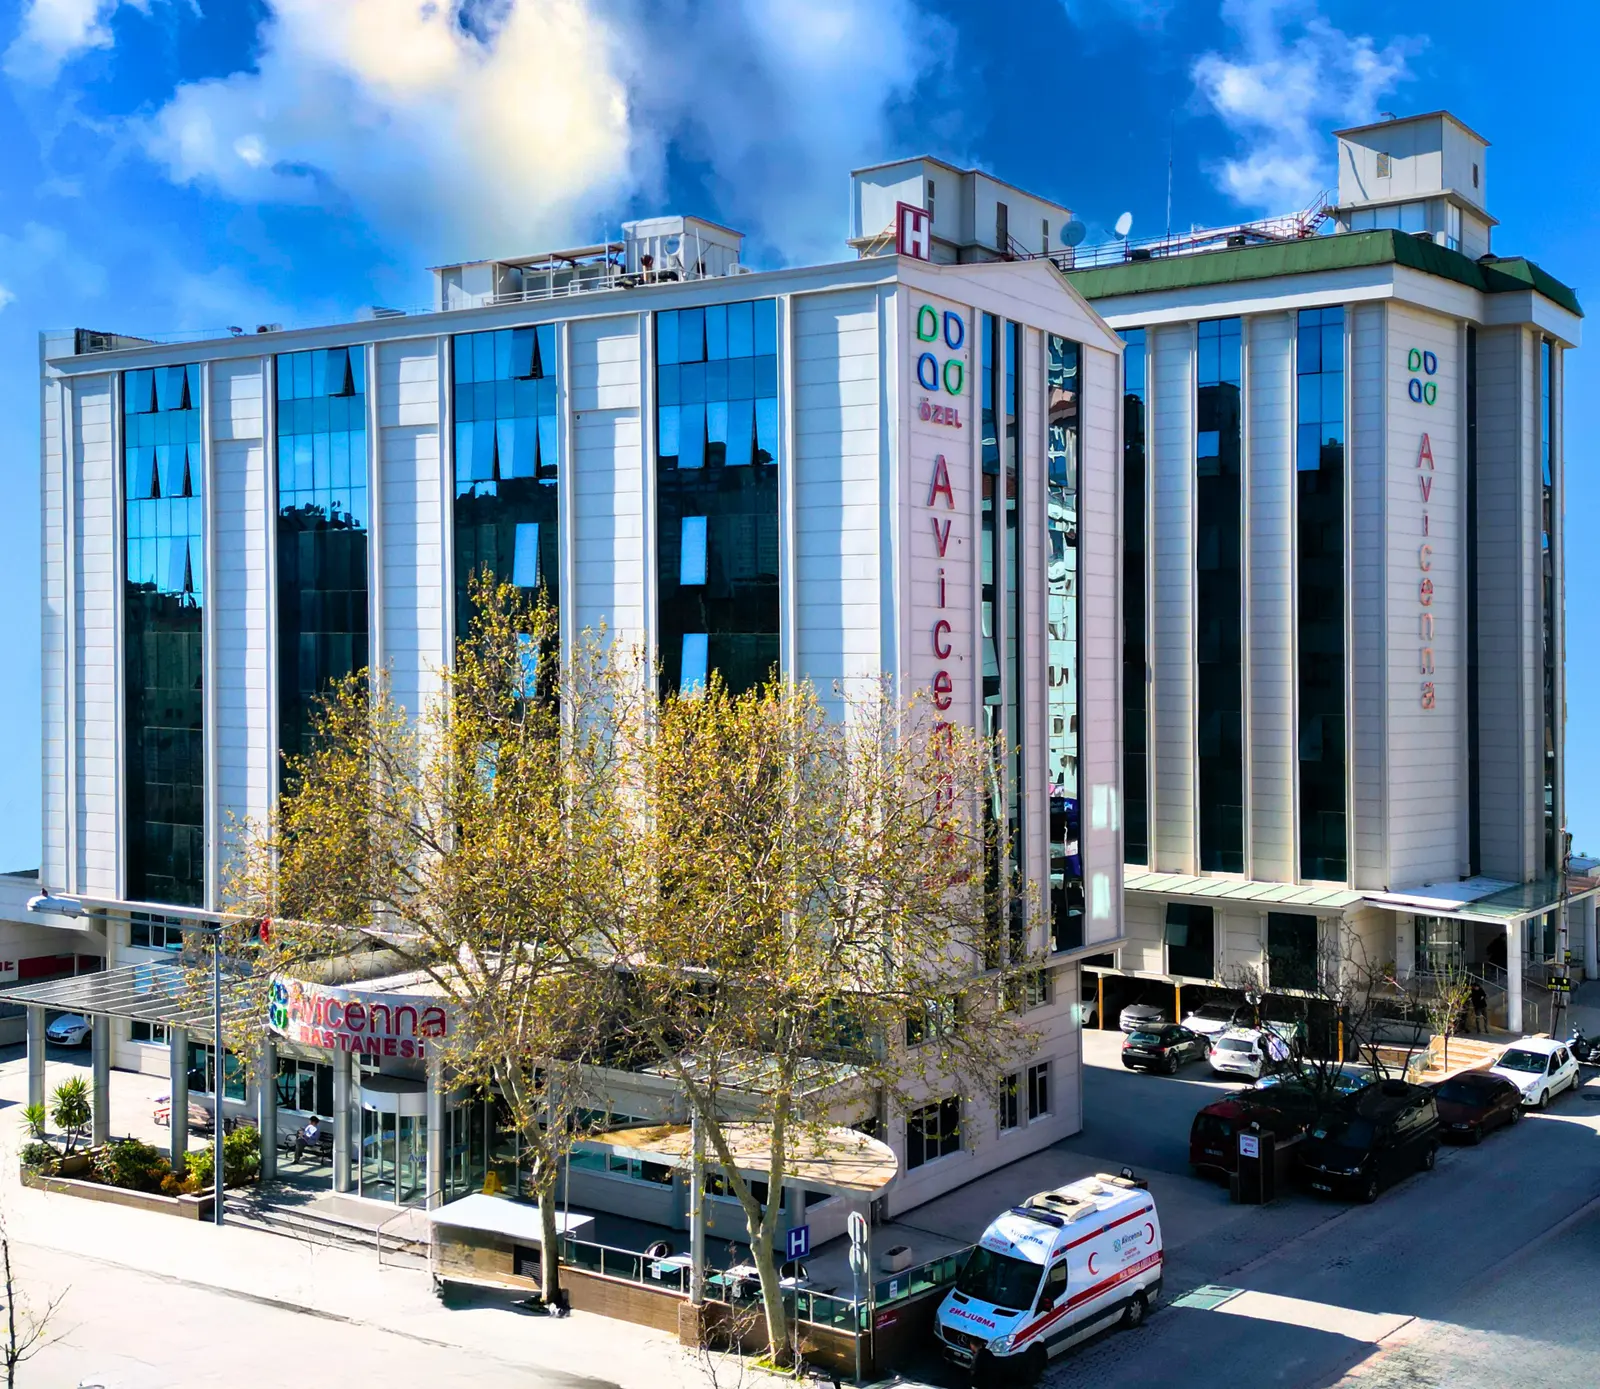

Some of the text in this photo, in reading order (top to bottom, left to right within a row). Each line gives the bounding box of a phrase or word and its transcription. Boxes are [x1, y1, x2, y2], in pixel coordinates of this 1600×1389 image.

[904, 210, 929, 261] H
[918, 396, 963, 429] ÖZEL
[1416, 432, 1435, 710] Avicenna
[286, 981, 447, 1038] Avicenna
[791, 1229, 805, 1256] H
